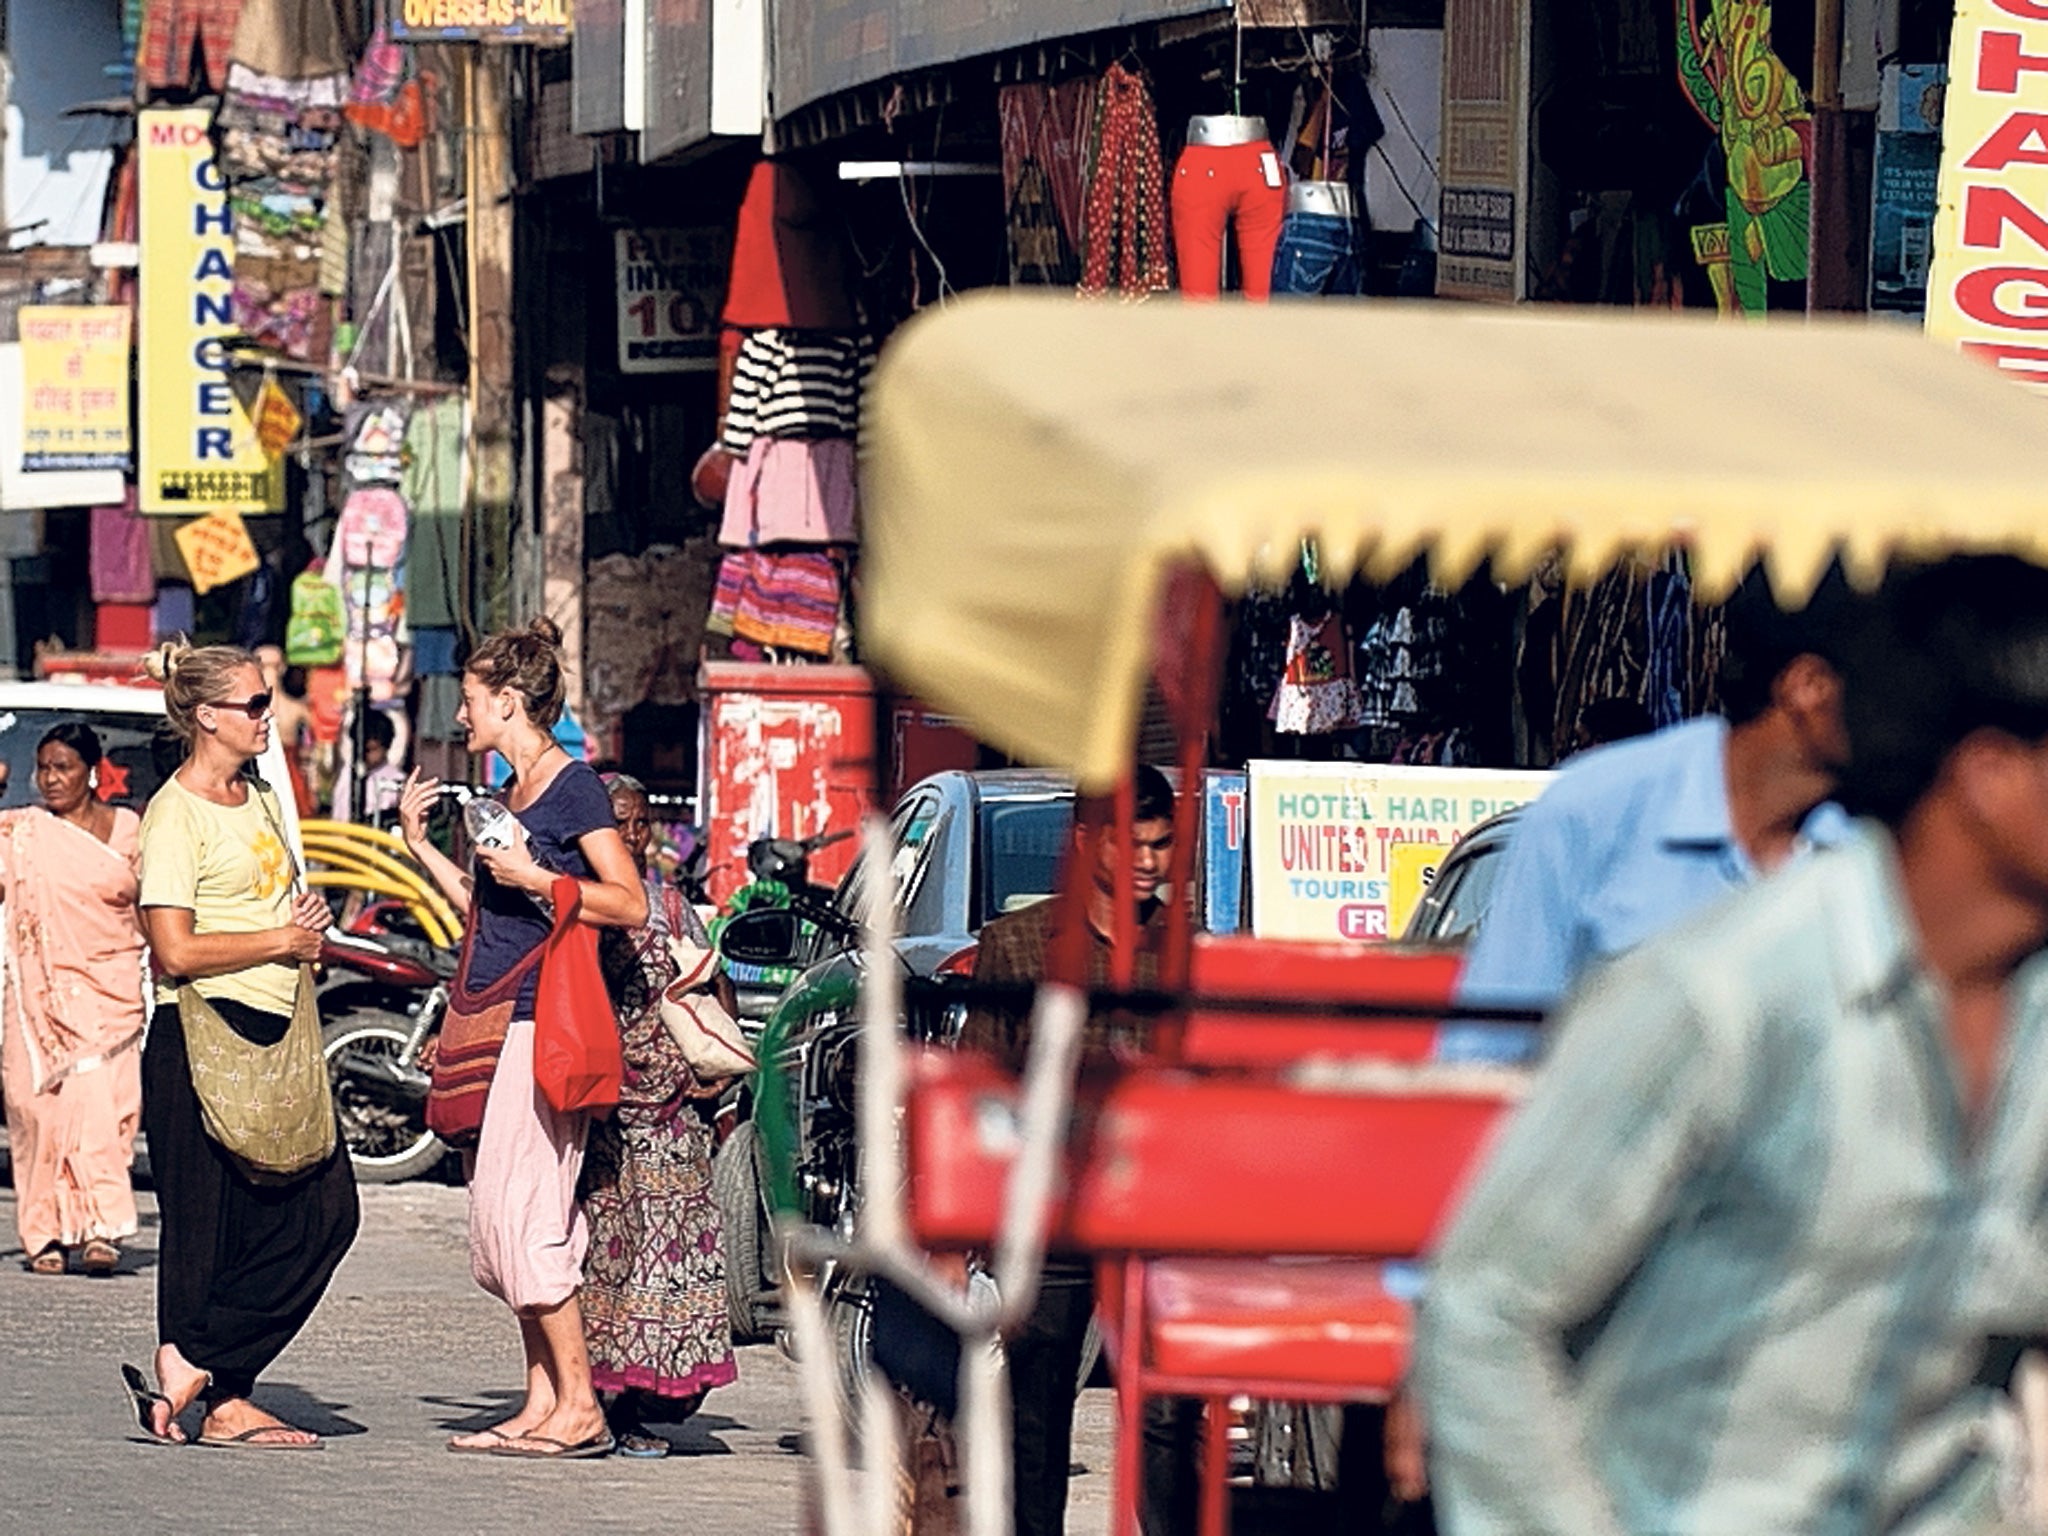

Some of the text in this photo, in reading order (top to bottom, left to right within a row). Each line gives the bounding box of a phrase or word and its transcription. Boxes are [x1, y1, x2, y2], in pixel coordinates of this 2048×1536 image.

[194, 160, 234, 460] CHANGER
[1279, 794, 1372, 820] HOTEL
[1387, 797, 1458, 823] HARI
[1281, 824, 1369, 873] UNITED
